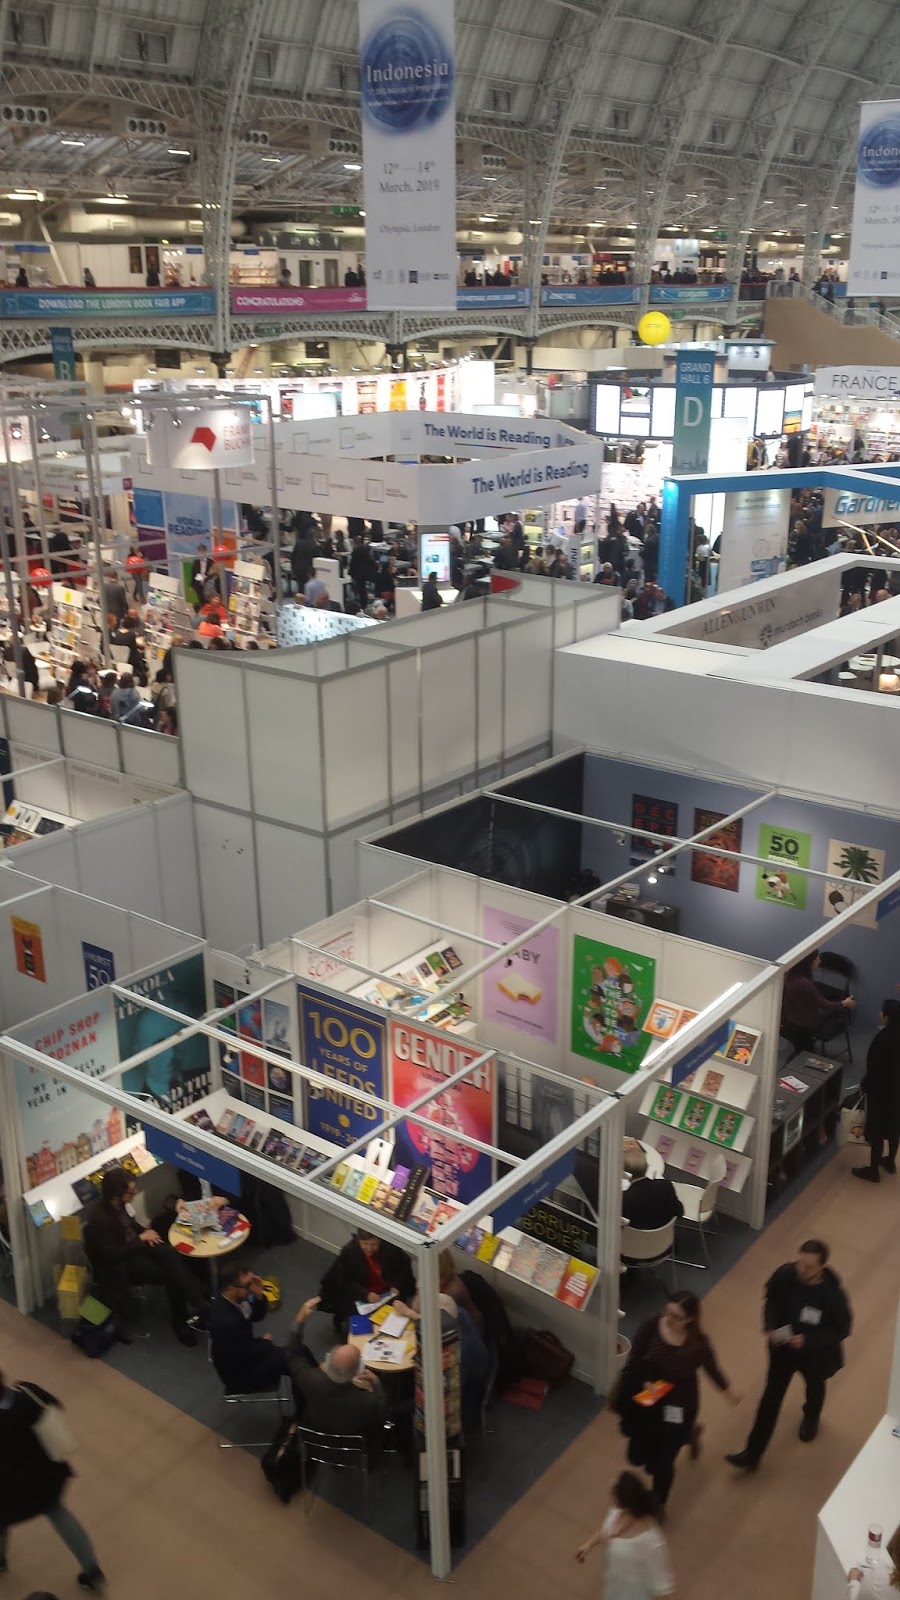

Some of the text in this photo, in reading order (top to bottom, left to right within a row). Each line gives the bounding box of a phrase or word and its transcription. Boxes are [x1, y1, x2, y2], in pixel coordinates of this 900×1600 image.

[366, 59, 449, 82] Indonesia
[416, 179, 440, 192] 2019
[38, 298, 84, 309] DOWNLOAD
[85, 298, 100, 309] THE
[101, 298, 132, 309] LONDON
[133, 298, 153, 309] BOOK
[171, 297, 186, 307] APP
[680, 362, 712, 373] GRAND
[680, 374, 701, 384] HALL
[832, 374, 898, 391] FRANCE
[683, 397, 704, 427] D
[424, 423, 446, 437] The
[447, 425, 484, 440] World
[486, 427, 496, 441] is
[500, 429, 551, 448] Reading
[471, 460, 590, 494] The World is Reading
[770, 835, 800, 856] 50
[34, 1011, 100, 1051] CHIP SHOP
[307, 1011, 377, 1059] 100
[319, 1046, 369, 1073] YEARS OF
[393, 1027, 490, 1093] GENDER
[27, 1092, 51, 1109] YEAR
[522, 1216, 581, 1253] BODIES
